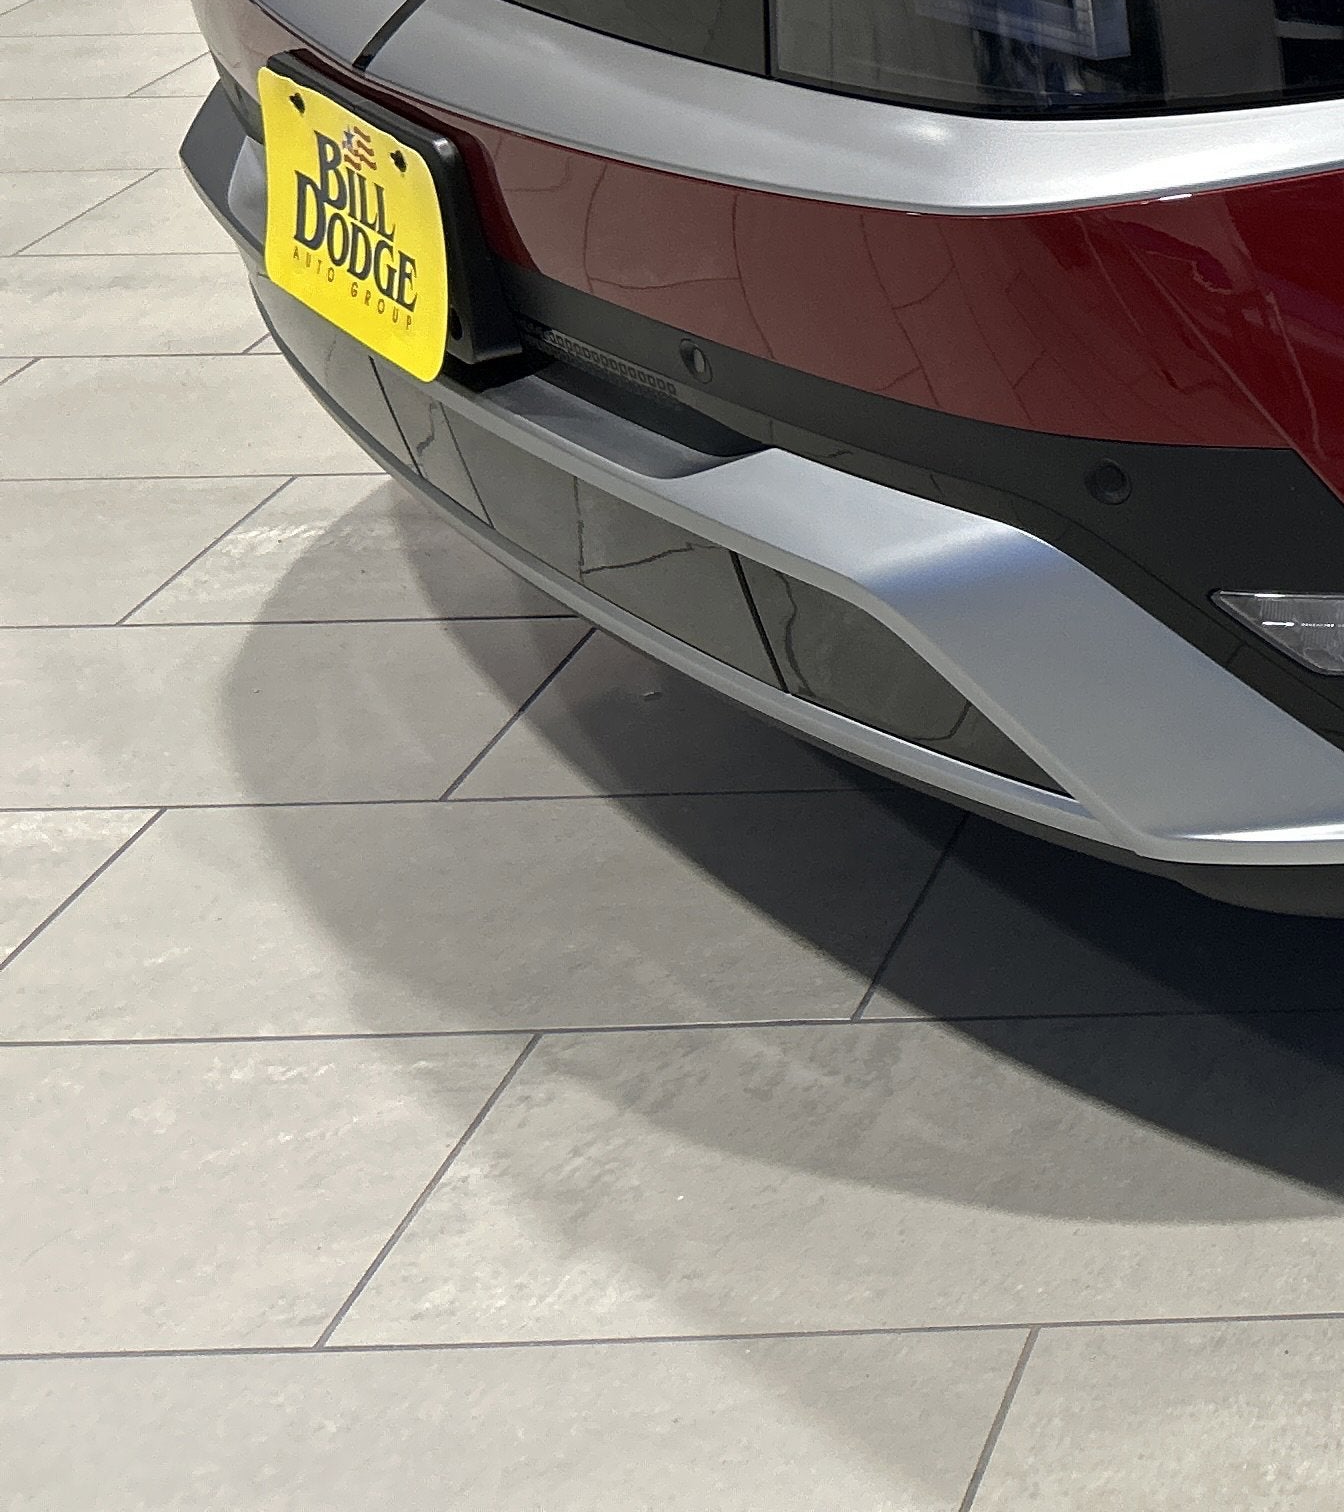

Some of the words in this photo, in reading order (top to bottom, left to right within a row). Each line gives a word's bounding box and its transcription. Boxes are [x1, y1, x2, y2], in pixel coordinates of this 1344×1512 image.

[293, 169, 418, 313] DODGE
[313, 130, 396, 243] BILL
[292, 245, 336, 284] AUTO
[350, 281, 414, 332] GROUP
